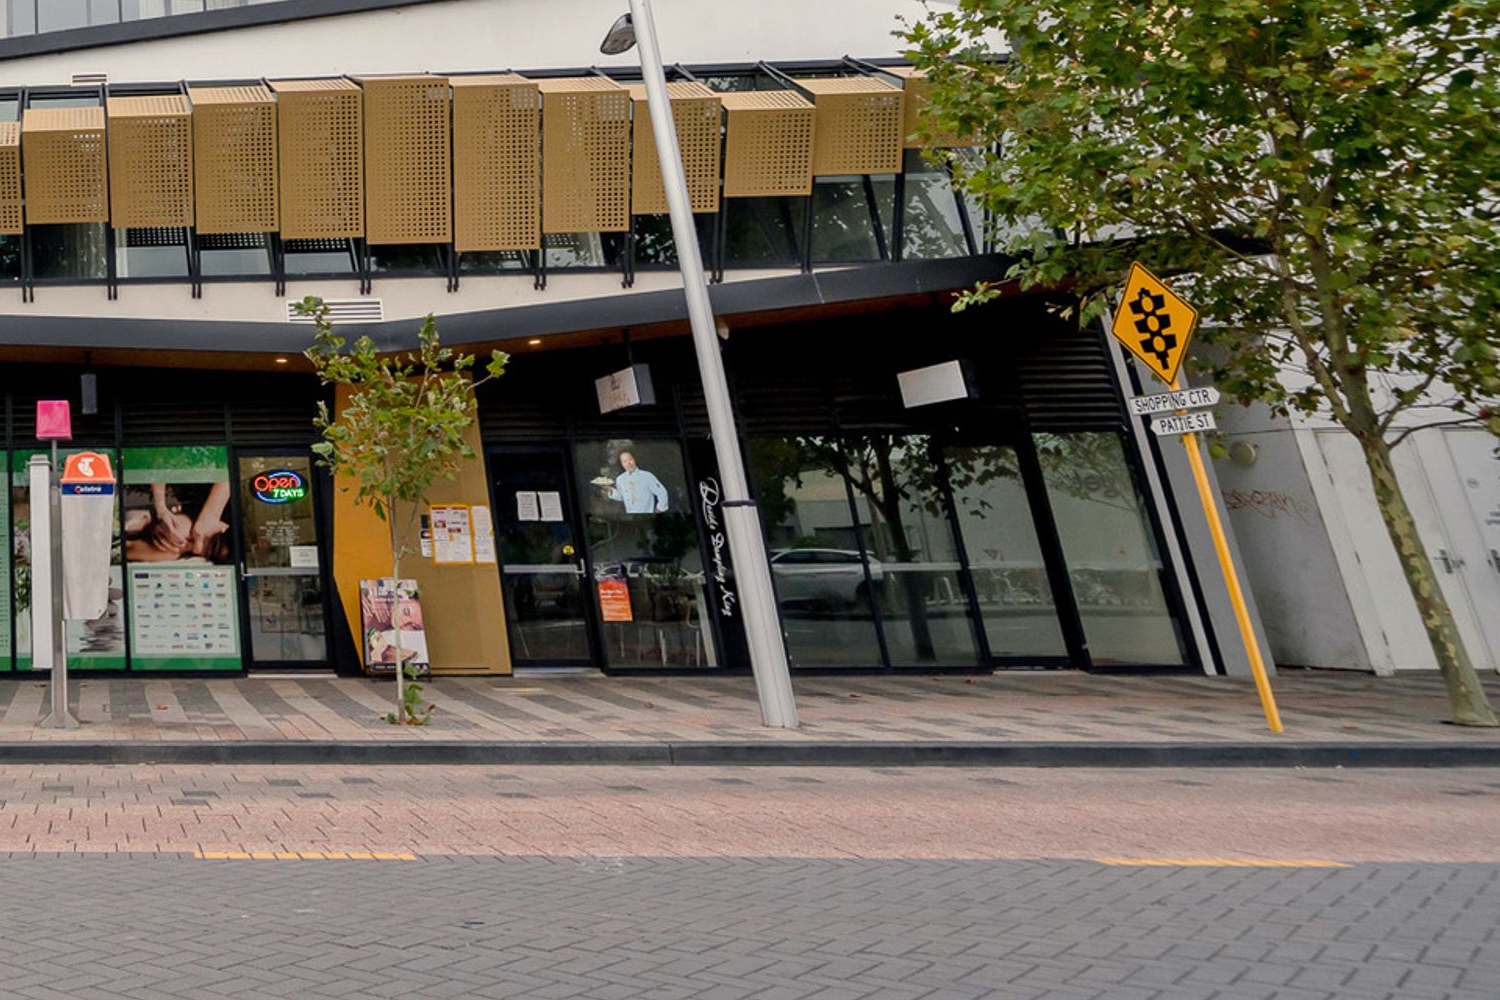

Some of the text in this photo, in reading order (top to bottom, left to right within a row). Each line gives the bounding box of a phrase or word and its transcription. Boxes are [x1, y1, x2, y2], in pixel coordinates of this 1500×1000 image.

[1135, 389, 1211, 412] SHOPPING CTR
[1160, 413, 1210, 432] PATTIE ST
[254, 475, 300, 492] Open
[279, 487, 304, 498] DAYS
